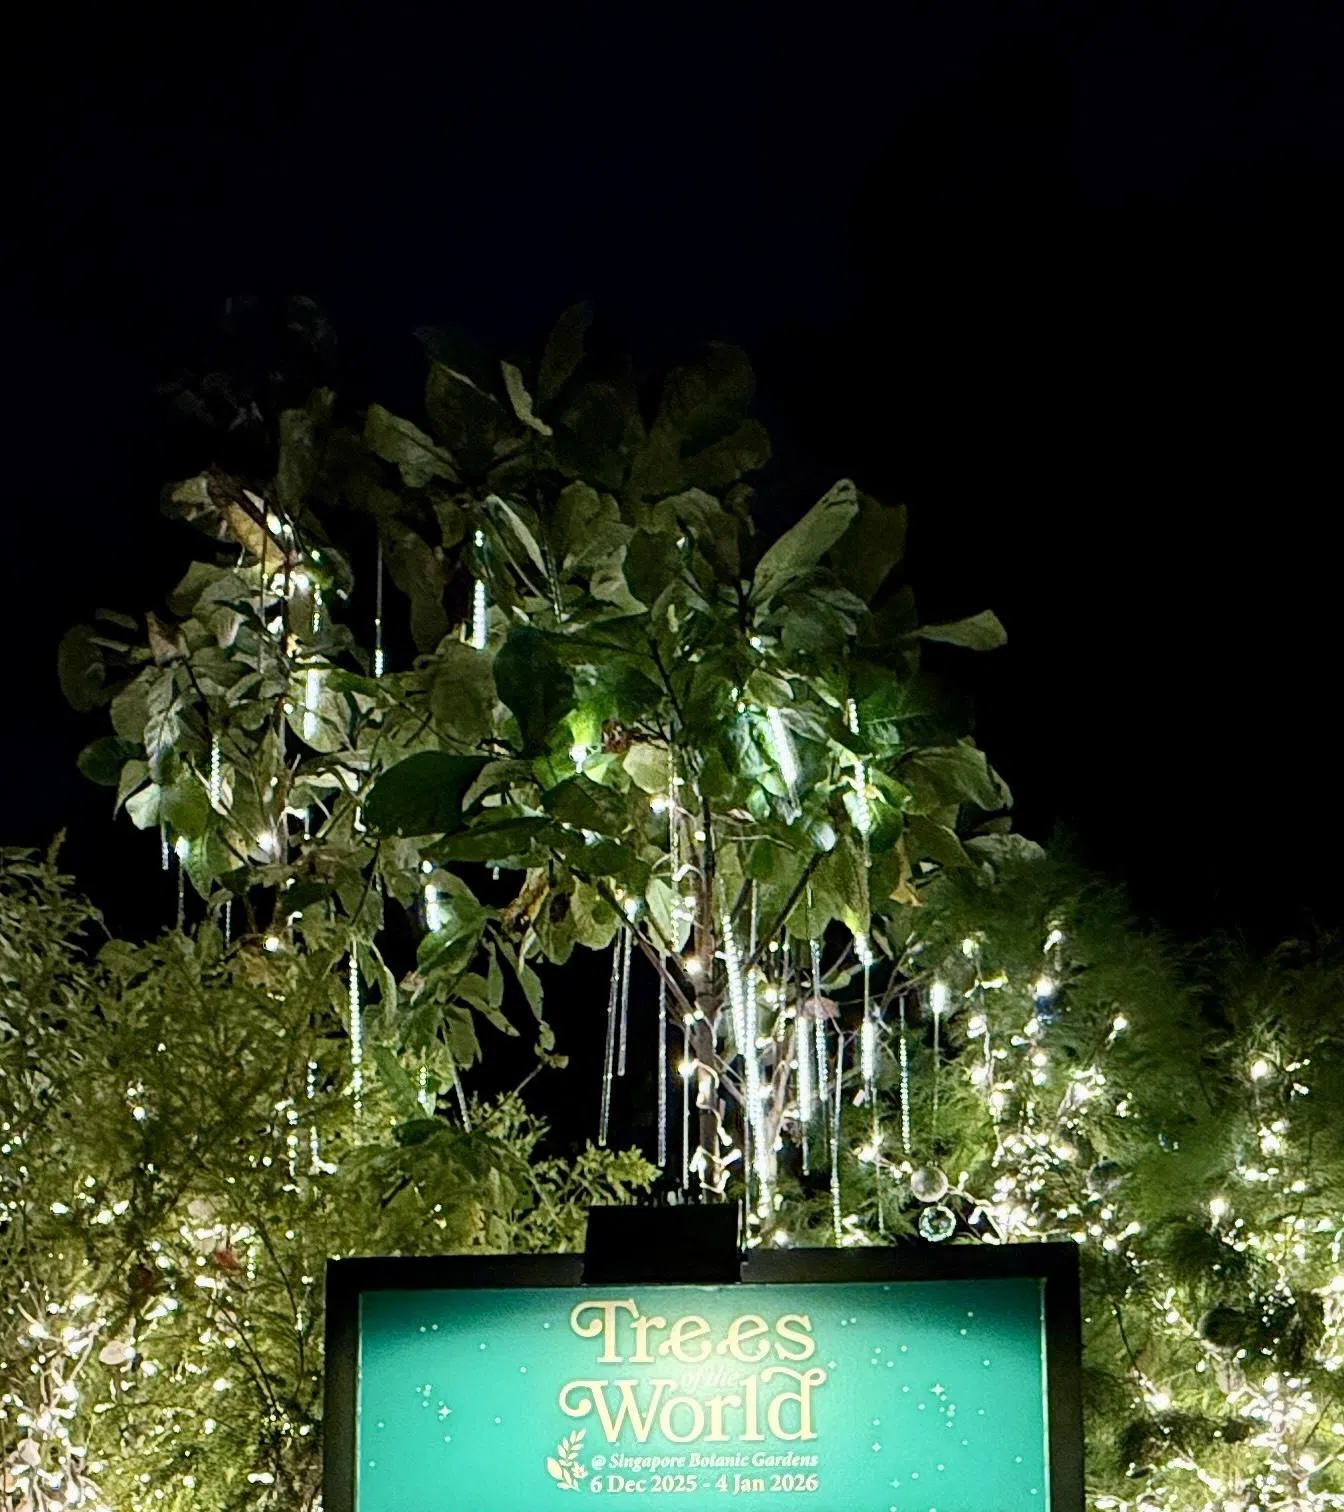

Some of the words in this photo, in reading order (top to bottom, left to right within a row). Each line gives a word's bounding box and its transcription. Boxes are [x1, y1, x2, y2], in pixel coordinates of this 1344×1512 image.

[570, 1298, 816, 1364] Trees
[681, 1367, 701, 1391] of
[705, 1365, 738, 1387] the
[559, 1366, 827, 1444] World
[590, 1454, 606, 1470] @
[608, 1452, 687, 1473] Singapore
[688, 1452, 749, 1469] Botanic
[751, 1452, 819, 1468] Gardens
[590, 1475, 603, 1493] 6
[608, 1475, 647, 1493] Dec
[651, 1475, 698, 1493] 2025
[715, 1475, 729, 1491] 4
[732, 1474, 766, 1496] Jan
[770, 1474, 819, 1492] 2026
